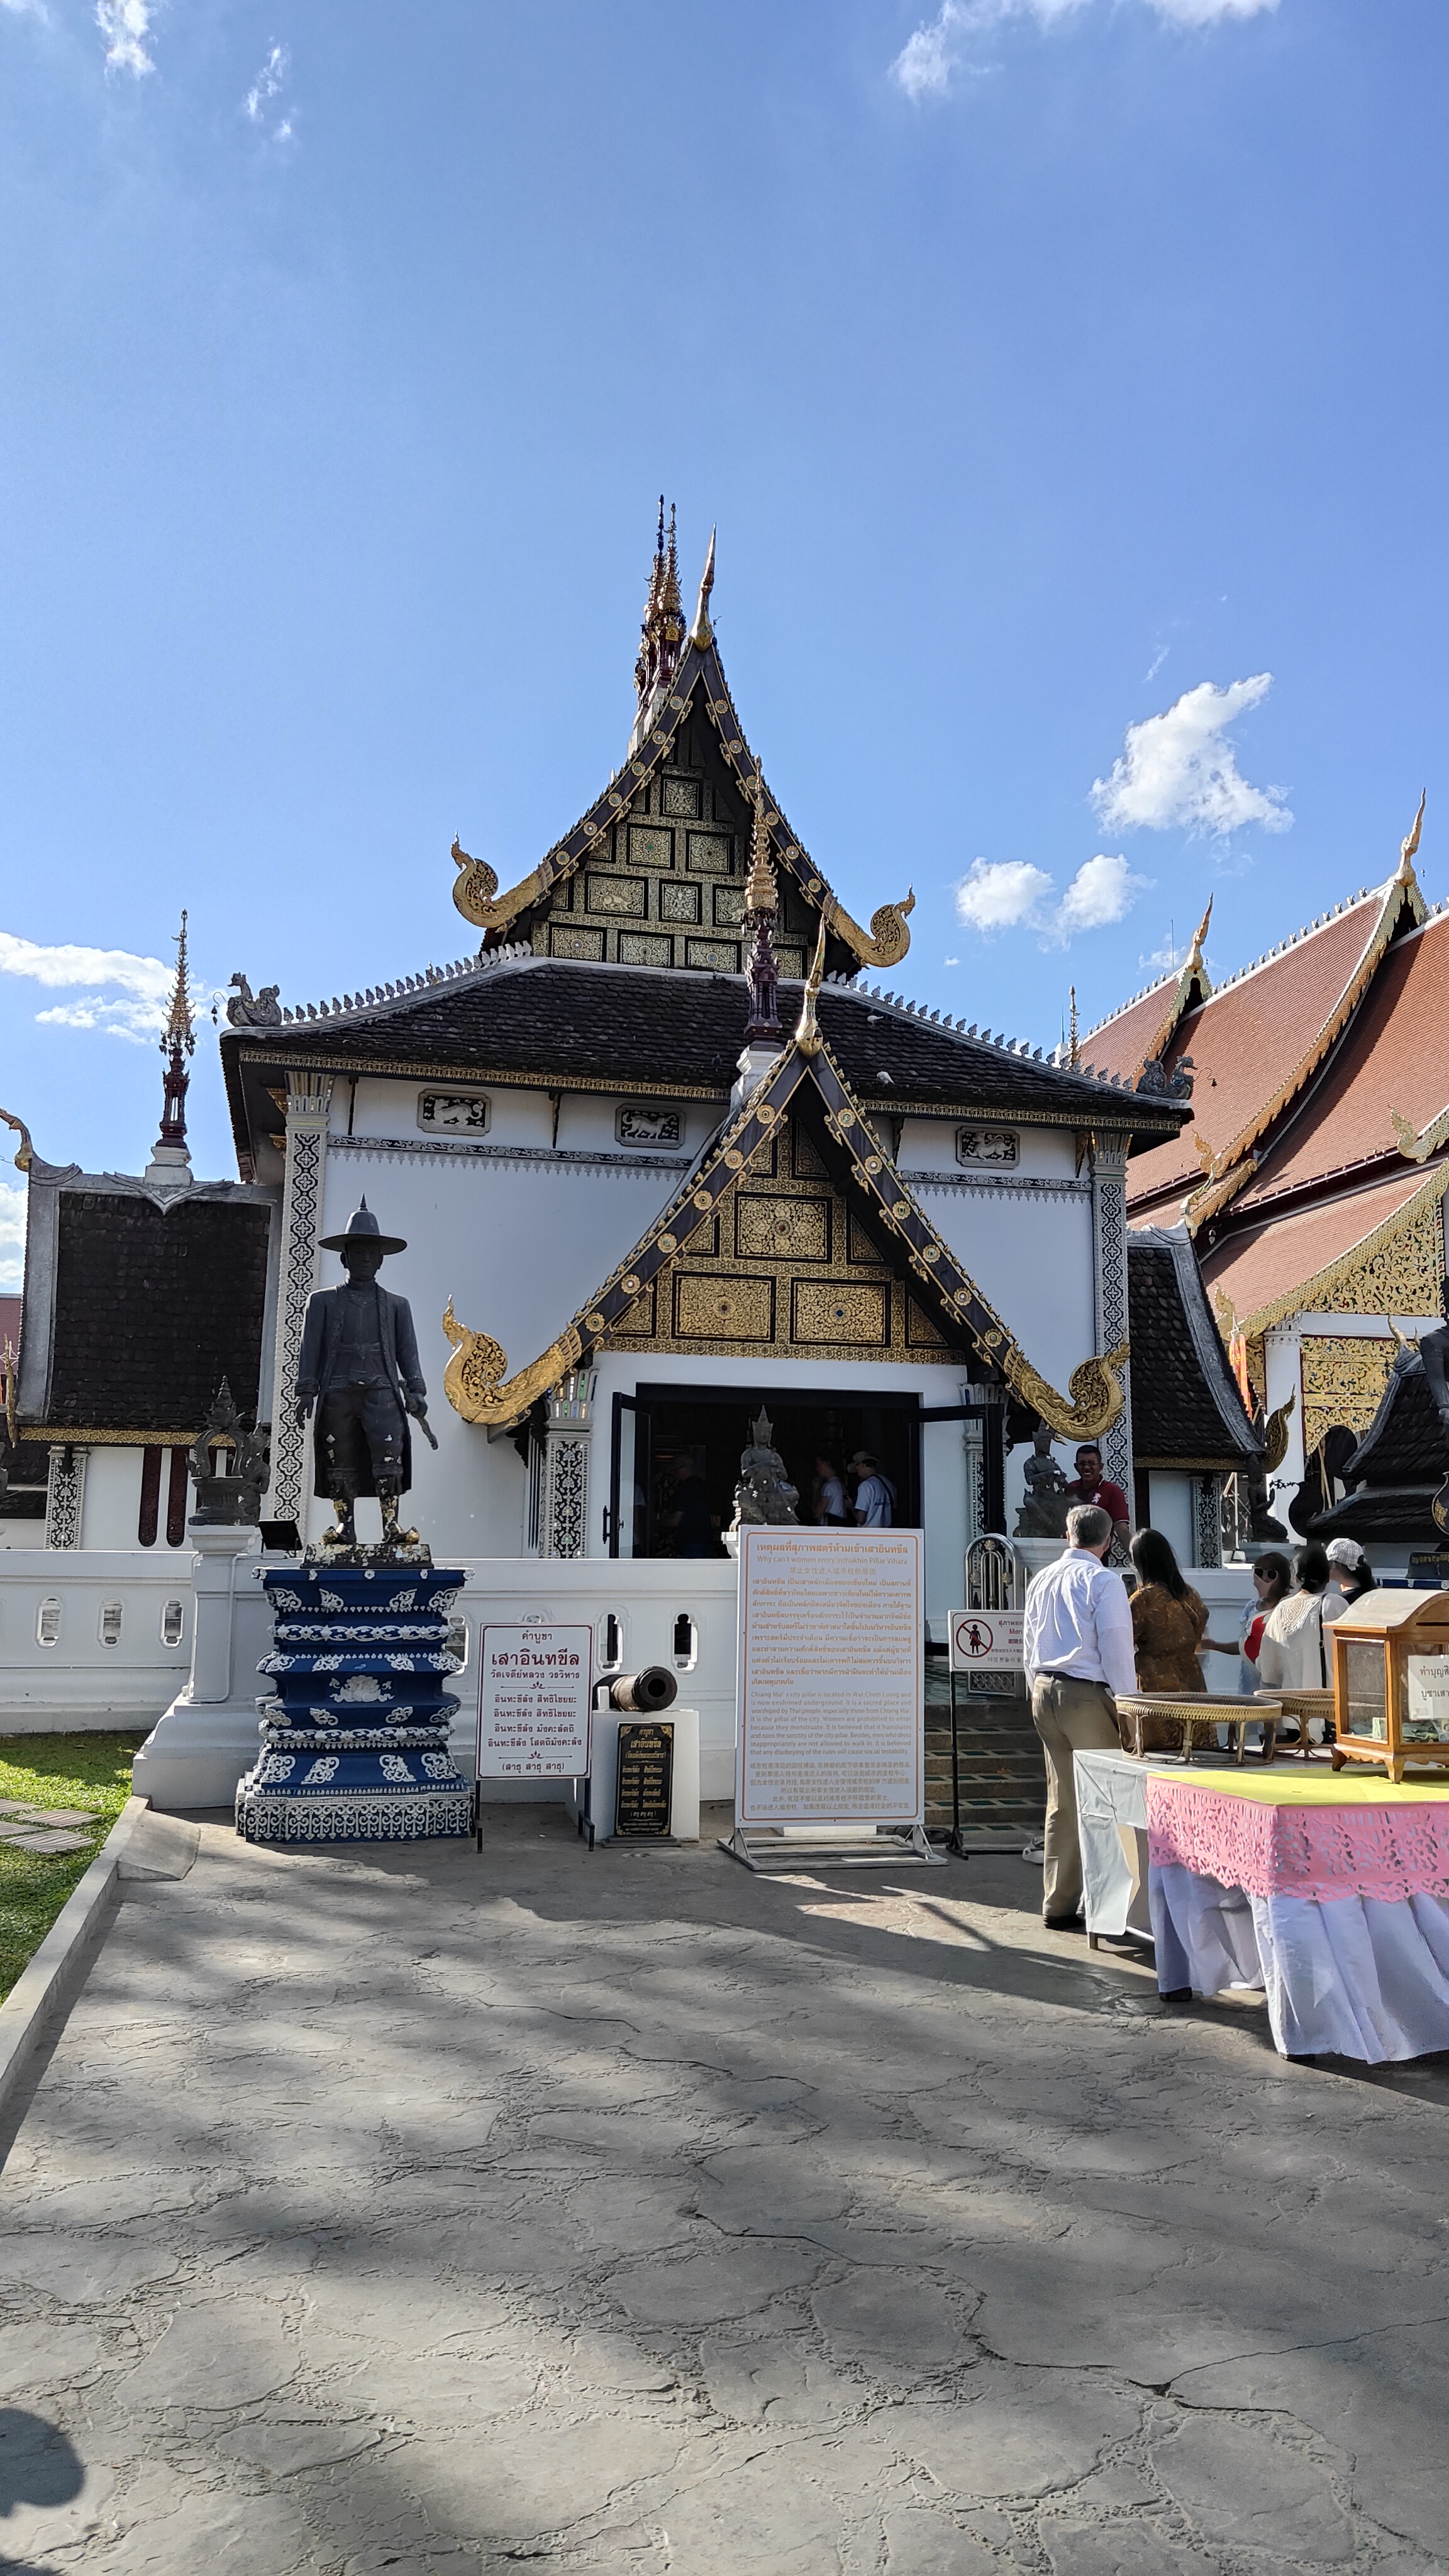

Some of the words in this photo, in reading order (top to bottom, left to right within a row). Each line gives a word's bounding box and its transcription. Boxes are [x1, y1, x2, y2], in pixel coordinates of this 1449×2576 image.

[492, 1648, 579, 1665] เสาอินทขีล
[491, 1669, 545, 1679] วัดเจดีย์หลวง
[502, 1763, 522, 1773] (สาธุ
[526, 1763, 541, 1773] สาธุ
[546, 1762, 564, 1773] สาธุ)
